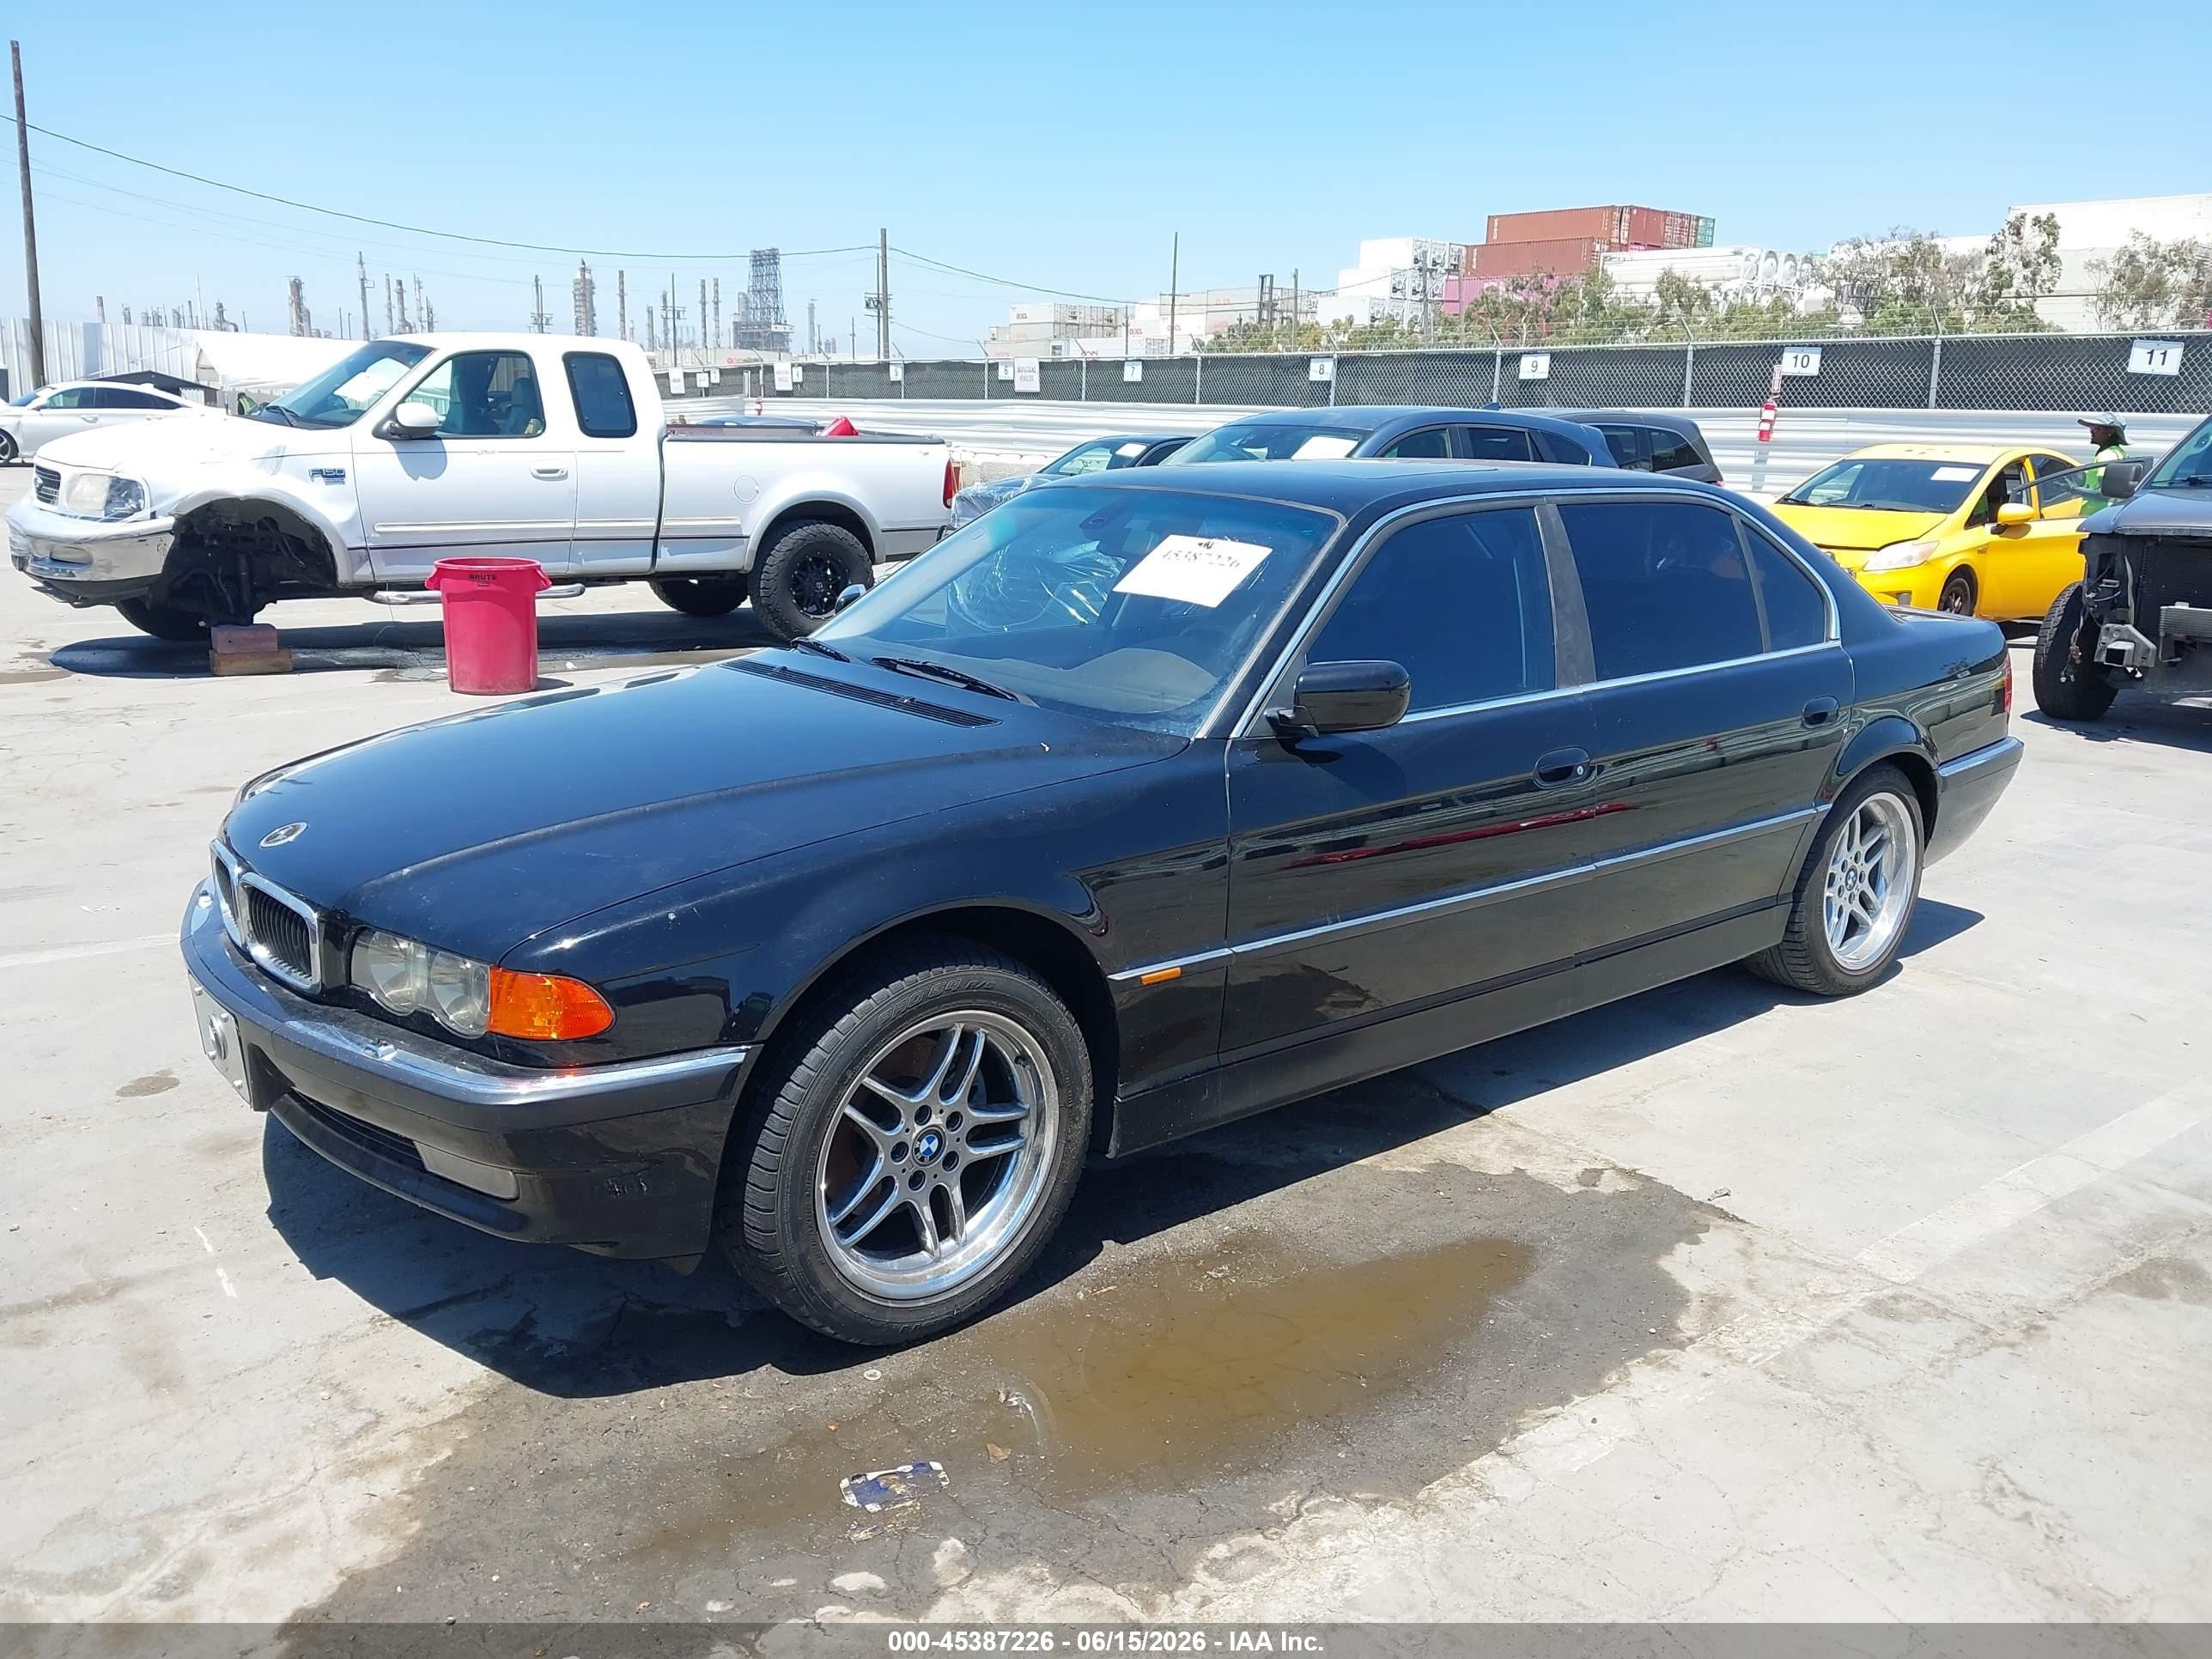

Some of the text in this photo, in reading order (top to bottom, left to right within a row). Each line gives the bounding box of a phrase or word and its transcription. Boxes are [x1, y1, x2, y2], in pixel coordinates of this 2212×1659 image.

[1792, 354, 1810, 368] 10
[2146, 349, 2168, 367] 11
[1004, 366, 1009, 376] 6
[1130, 366, 1135, 377] 7
[1318, 363, 1325, 375] 8
[1531, 360, 1539, 373] 9
